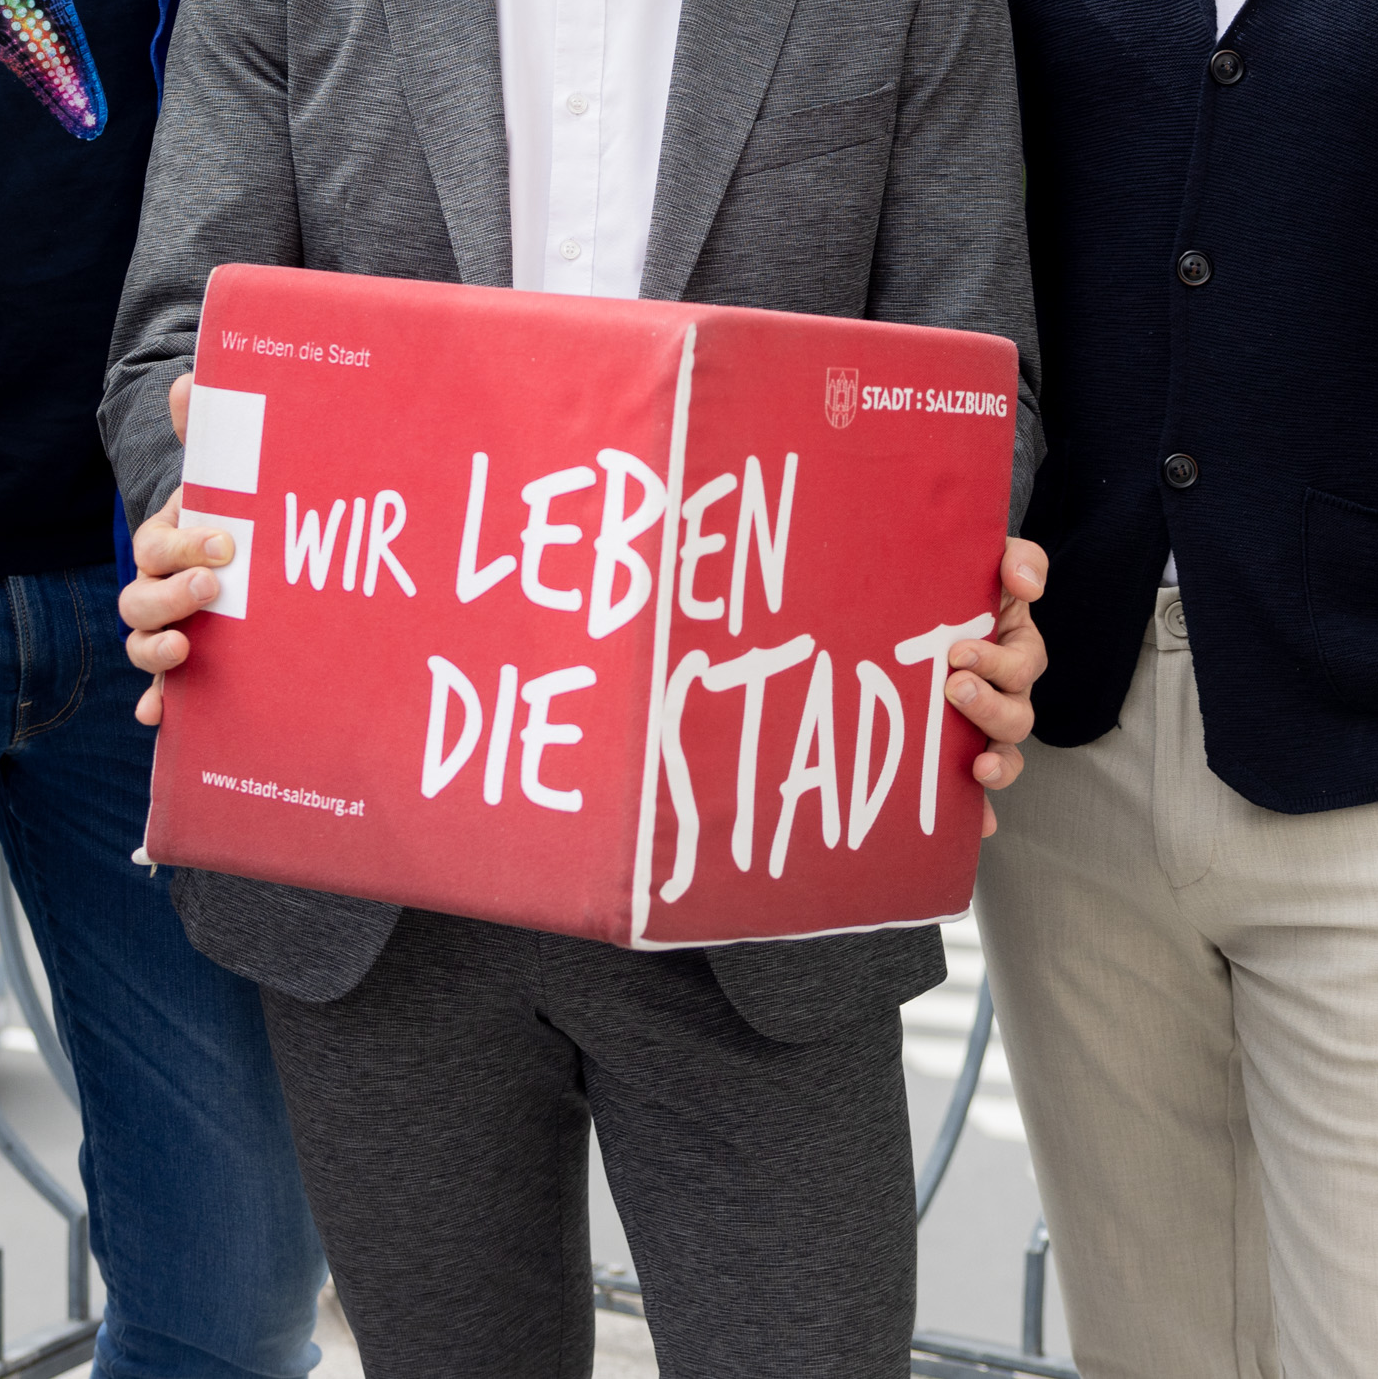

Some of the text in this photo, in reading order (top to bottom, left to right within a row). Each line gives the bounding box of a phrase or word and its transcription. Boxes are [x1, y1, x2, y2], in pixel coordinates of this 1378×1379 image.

[221, 330, 371, 368] Wir leben die Stadt
[861, 385, 914, 411] STADT
[925, 388, 1008, 418] SALZBURG
[283, 447, 799, 640] WIR LEBEN
[420, 612, 996, 904] DIE STADT
[201, 770, 366, 817] www.stadt-salzburg.at
